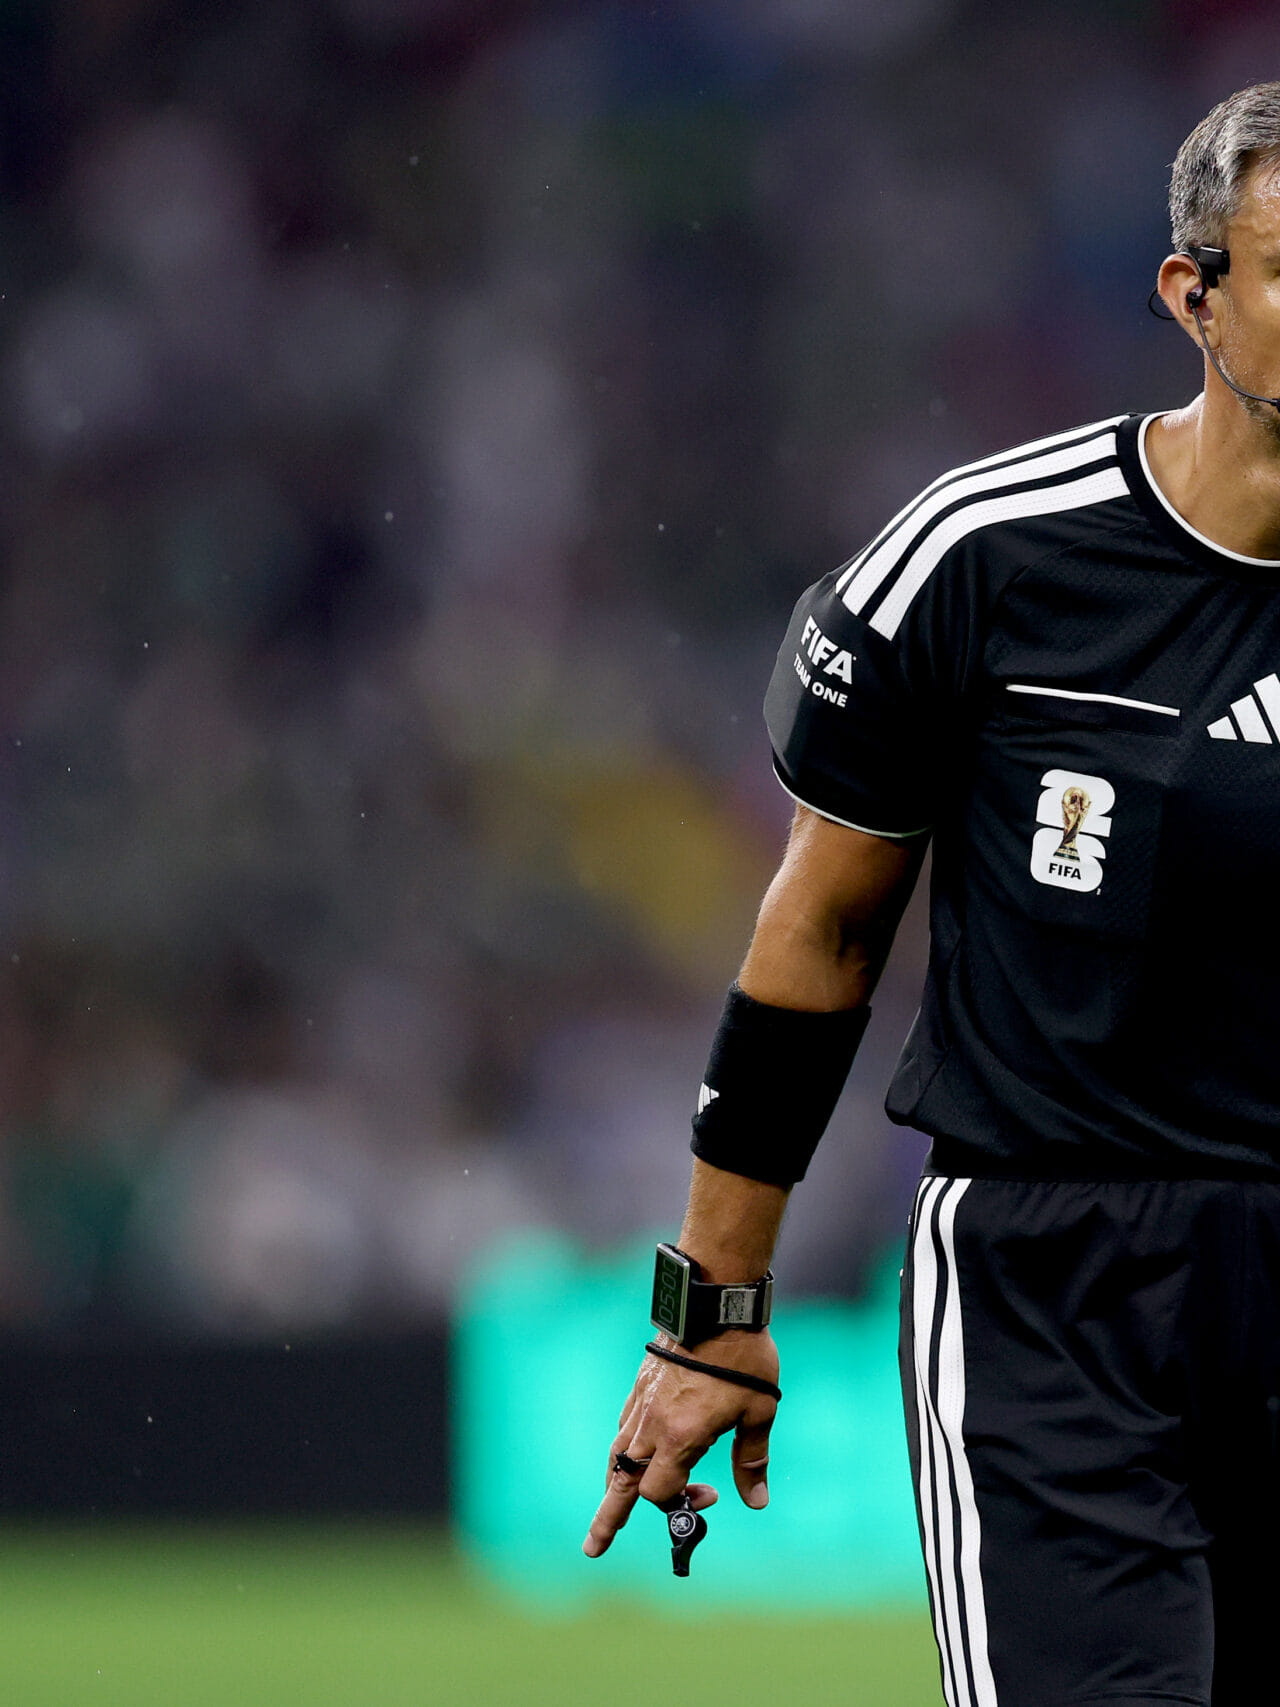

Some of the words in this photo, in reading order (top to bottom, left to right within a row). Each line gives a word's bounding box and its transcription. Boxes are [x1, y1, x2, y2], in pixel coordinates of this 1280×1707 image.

[801, 614, 853, 685] FIFA
[812, 682, 848, 708] ONE
[1048, 863, 1081, 880] FIFA
